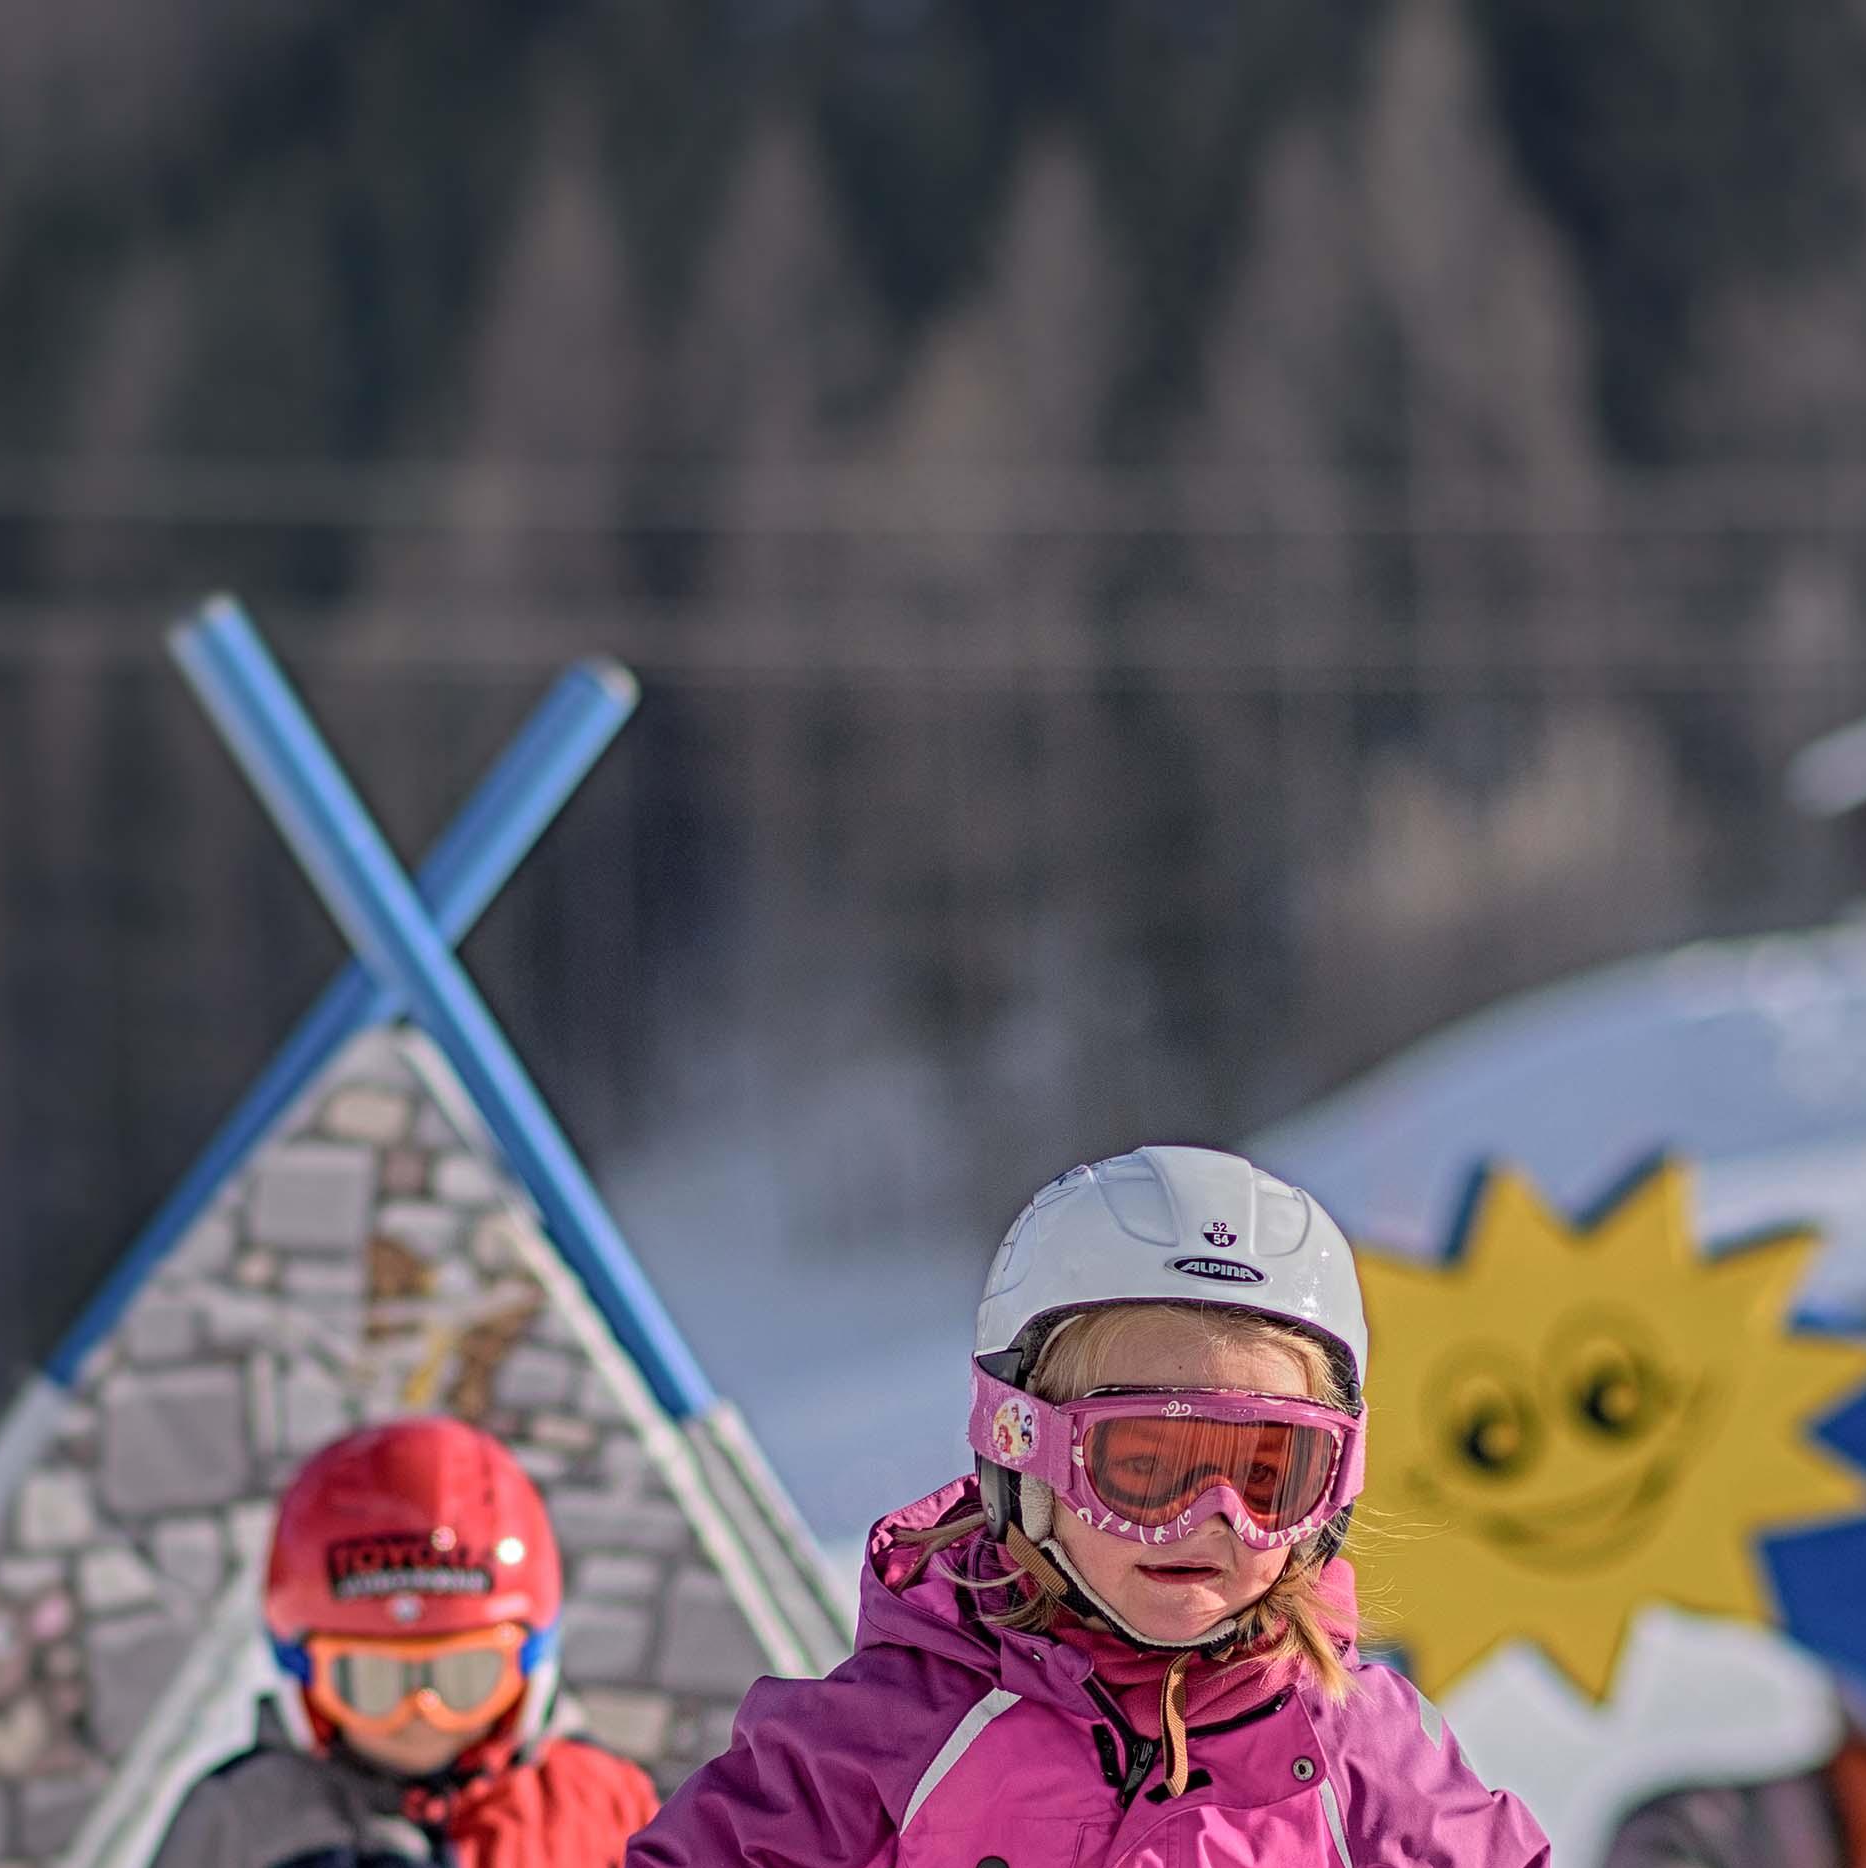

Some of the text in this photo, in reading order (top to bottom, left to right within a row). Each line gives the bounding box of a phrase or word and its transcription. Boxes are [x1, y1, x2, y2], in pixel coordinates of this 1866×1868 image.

[1212, 1222, 1228, 1232] 52
[1213, 1234, 1229, 1246] 54
[1180, 1261, 1258, 1282] ALPINA
[333, 1542, 490, 1578] TOYOT
